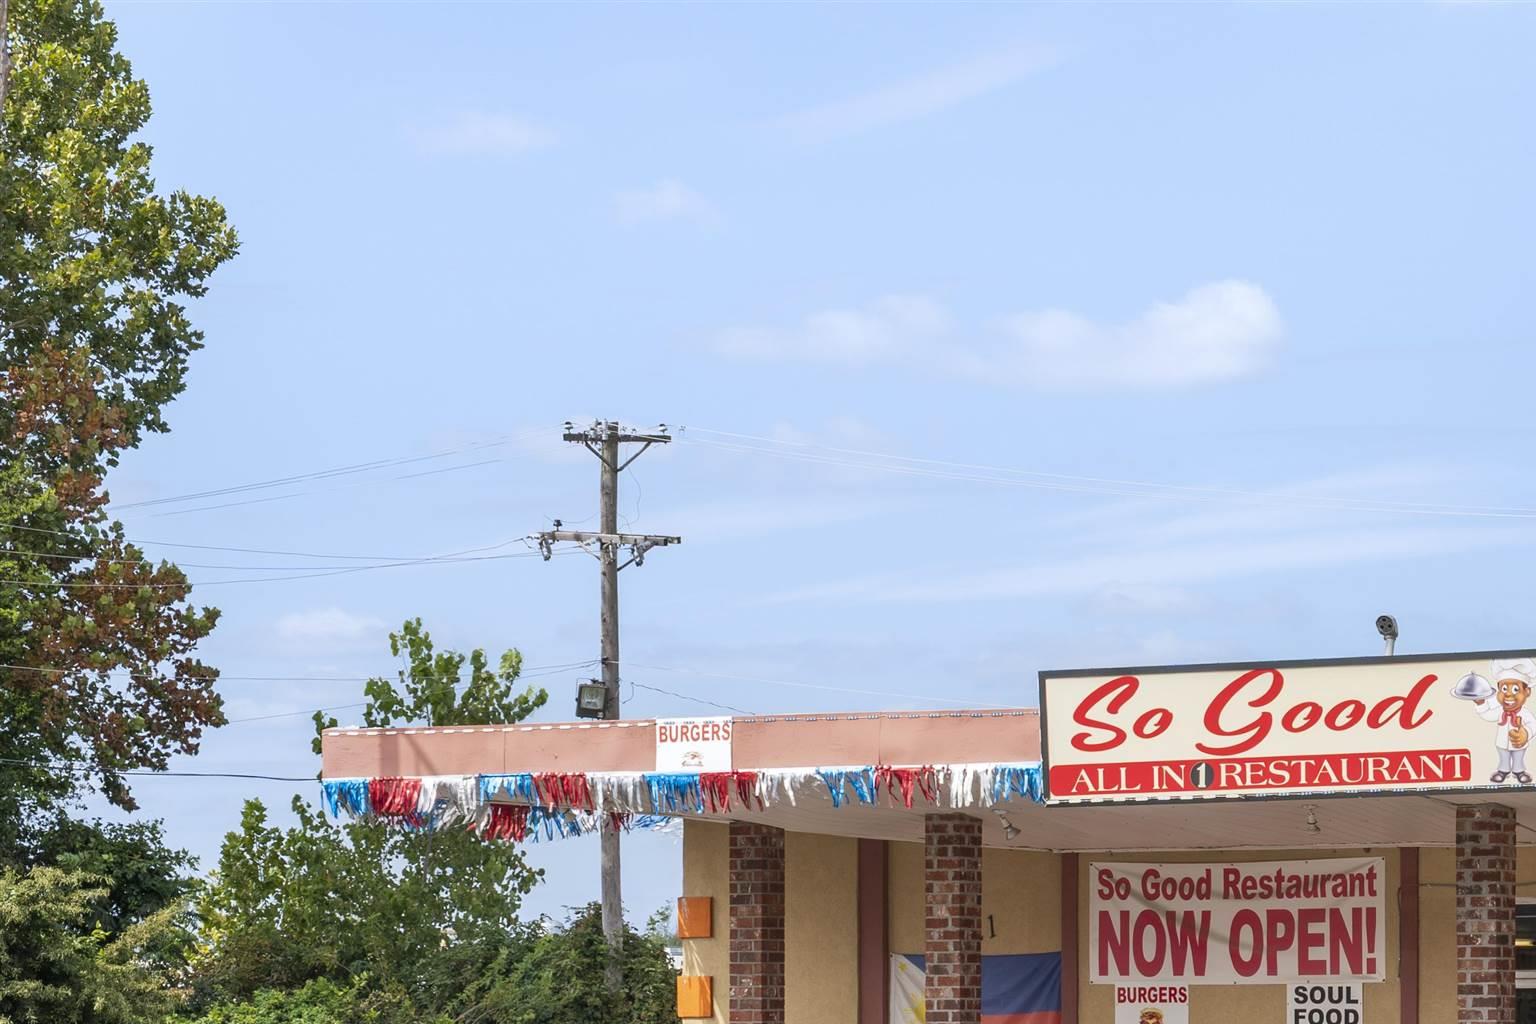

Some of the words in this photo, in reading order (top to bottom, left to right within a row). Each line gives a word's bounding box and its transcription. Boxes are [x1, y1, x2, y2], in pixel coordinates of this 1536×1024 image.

[1070, 676, 1174, 752] So
[1195, 668, 1439, 756] Good
[659, 723, 730, 743] BURGERS
[1072, 766, 1140, 794] ALL
[1153, 764, 1186, 790] IN
[1196, 762, 1208, 788] 1
[1219, 754, 1470, 788] RESTAURANT
[1097, 868, 1132, 901] So
[1141, 868, 1212, 900] Good
[1222, 865, 1377, 900] Restaurant
[1098, 908, 1212, 977] NOW
[1228, 907, 1377, 977] OPEN!
[1117, 986, 1187, 1004] BURGERS
[1294, 986, 1359, 1005] SOUL
